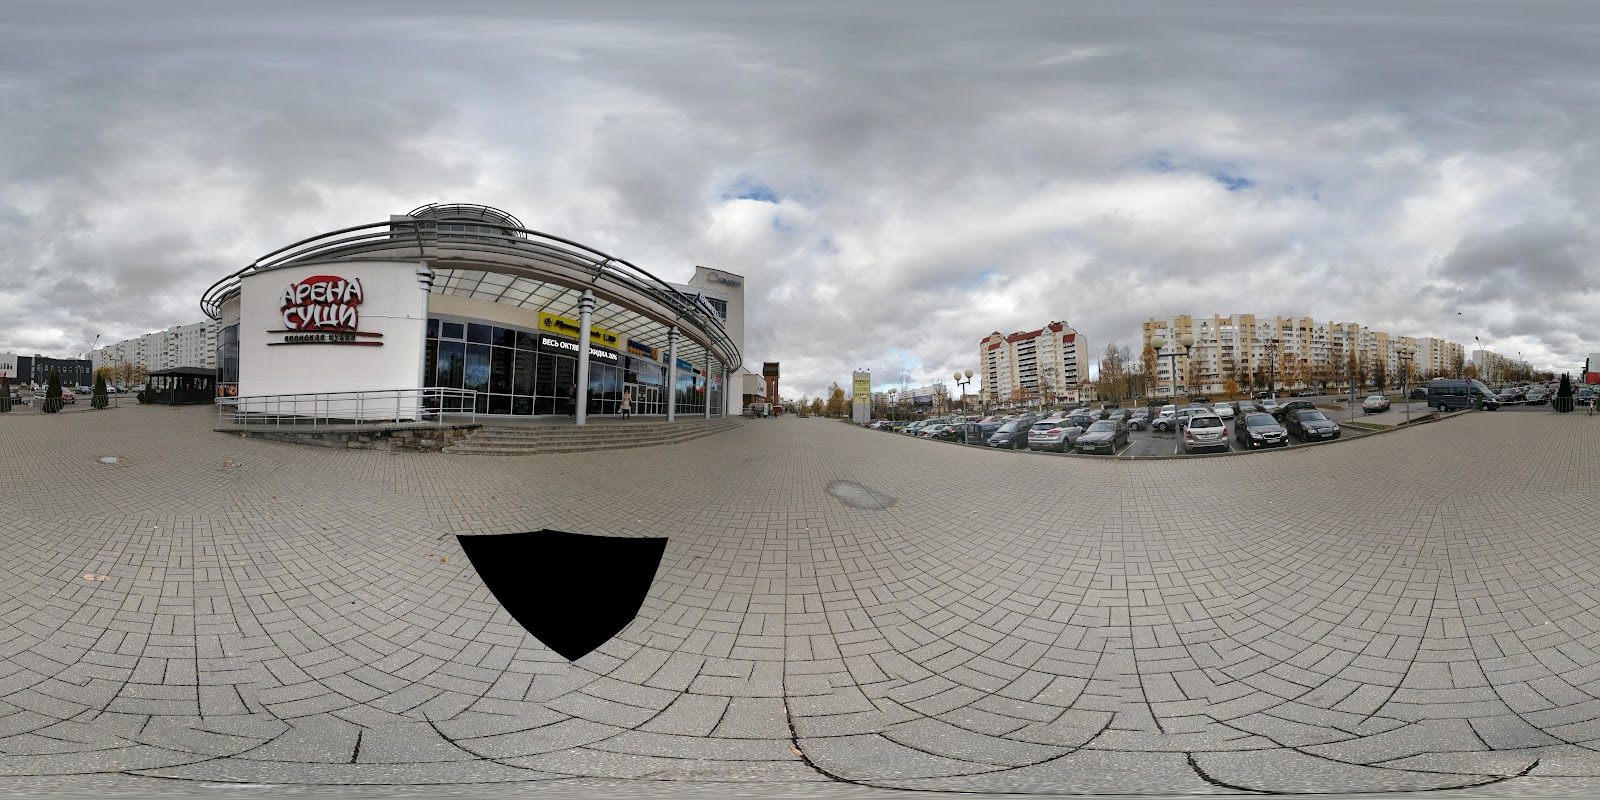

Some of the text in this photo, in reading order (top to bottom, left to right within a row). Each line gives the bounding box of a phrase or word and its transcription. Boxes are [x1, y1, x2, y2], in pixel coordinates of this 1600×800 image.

[280, 278, 362, 310] АРЕНА
[283, 303, 358, 330] СУШИ
[542, 337, 559, 348] ВЕСЬ
[560, 341, 580, 352] ОКТЯБ
